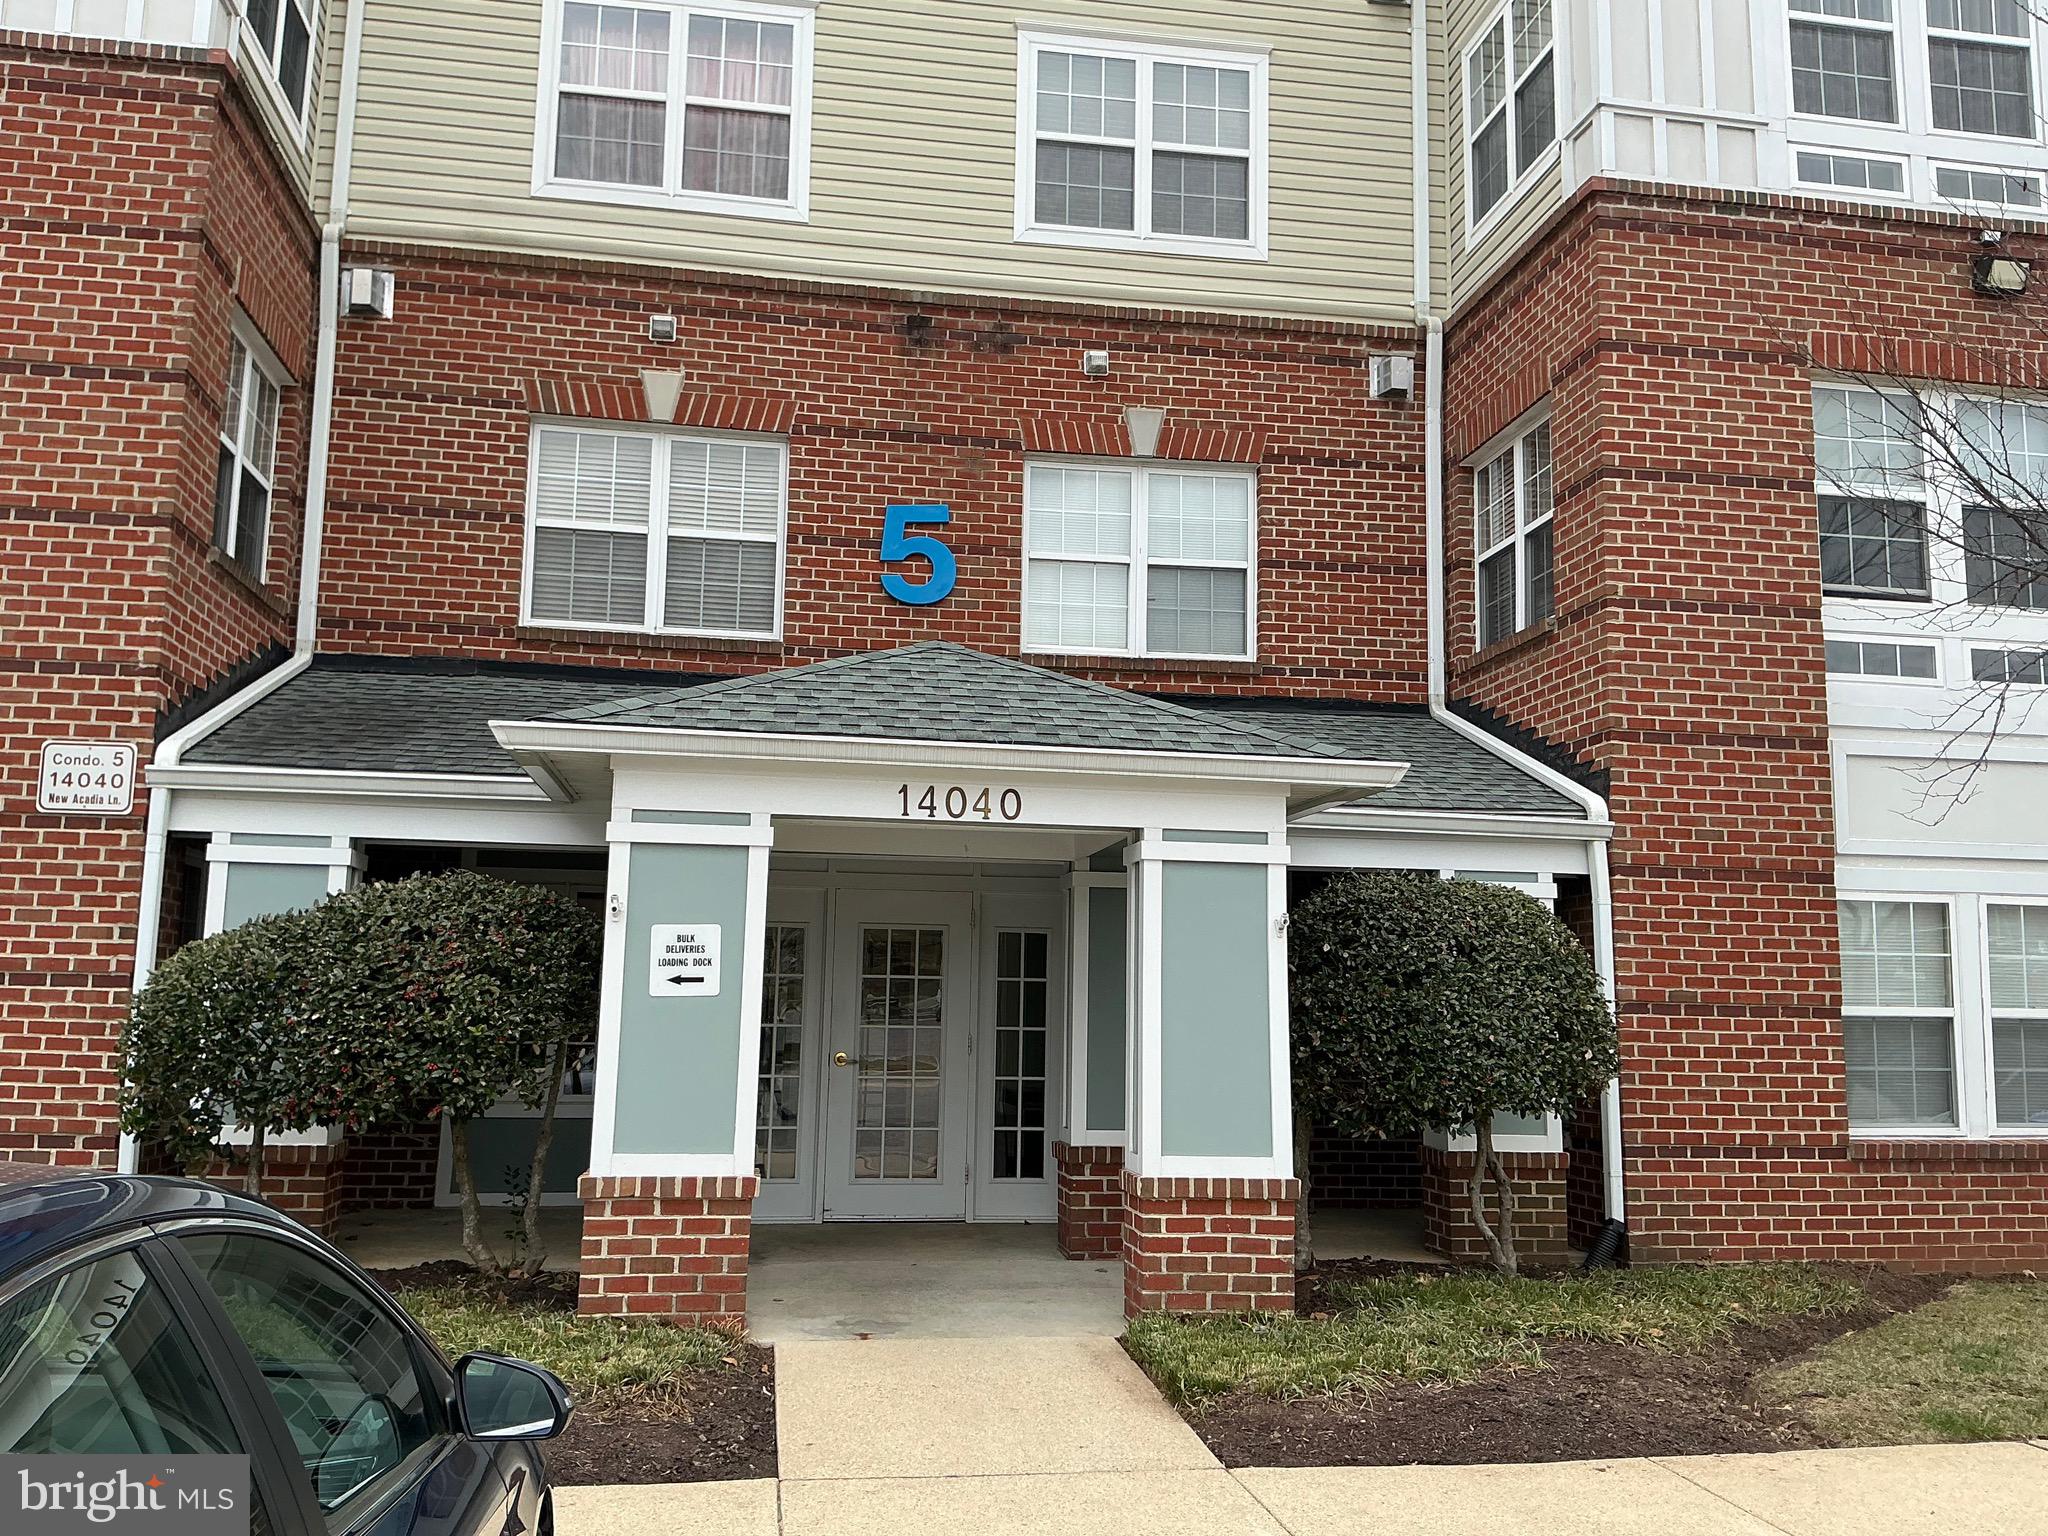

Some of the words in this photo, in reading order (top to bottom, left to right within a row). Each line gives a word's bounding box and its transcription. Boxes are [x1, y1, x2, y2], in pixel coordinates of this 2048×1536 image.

[880, 504, 957, 605] 5
[53, 753, 104, 766] Condo.
[113, 752, 124, 766] 5
[50, 772, 124, 788] 14040
[48, 793, 68, 803] New
[72, 794, 104, 805] Acadia
[108, 795, 121, 805] Ln.
[898, 784, 1022, 820] 14040
[676, 934, 695, 942] BULK
[665, 945, 706, 953] DELIVERIES
[658, 958, 688, 967] LOADING
[692, 958, 712, 967] DOCK
